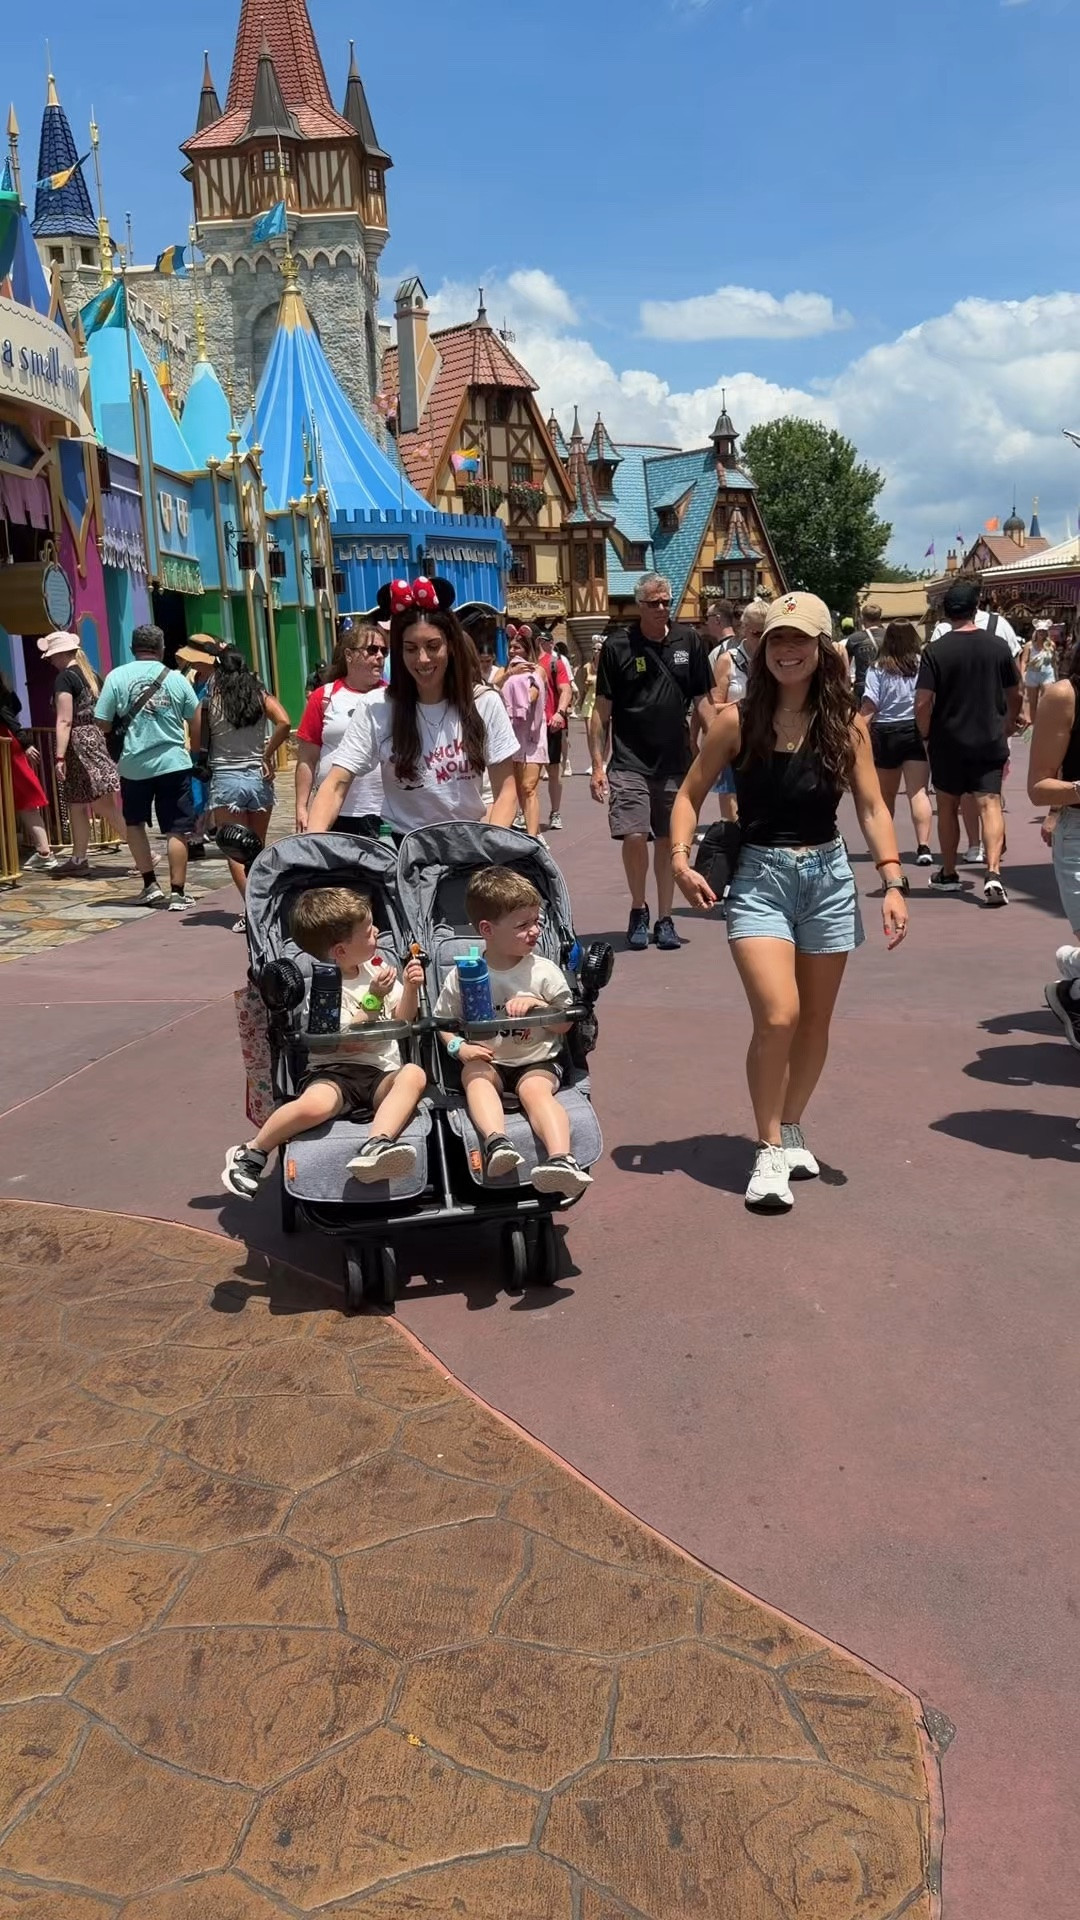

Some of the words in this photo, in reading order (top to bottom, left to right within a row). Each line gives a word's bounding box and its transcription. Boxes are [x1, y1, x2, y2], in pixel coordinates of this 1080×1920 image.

[3, 339, 14, 368] a
[19, 346, 61, 387] small
[423, 739, 464, 771] MICK
[435, 760, 473, 784] MOU
